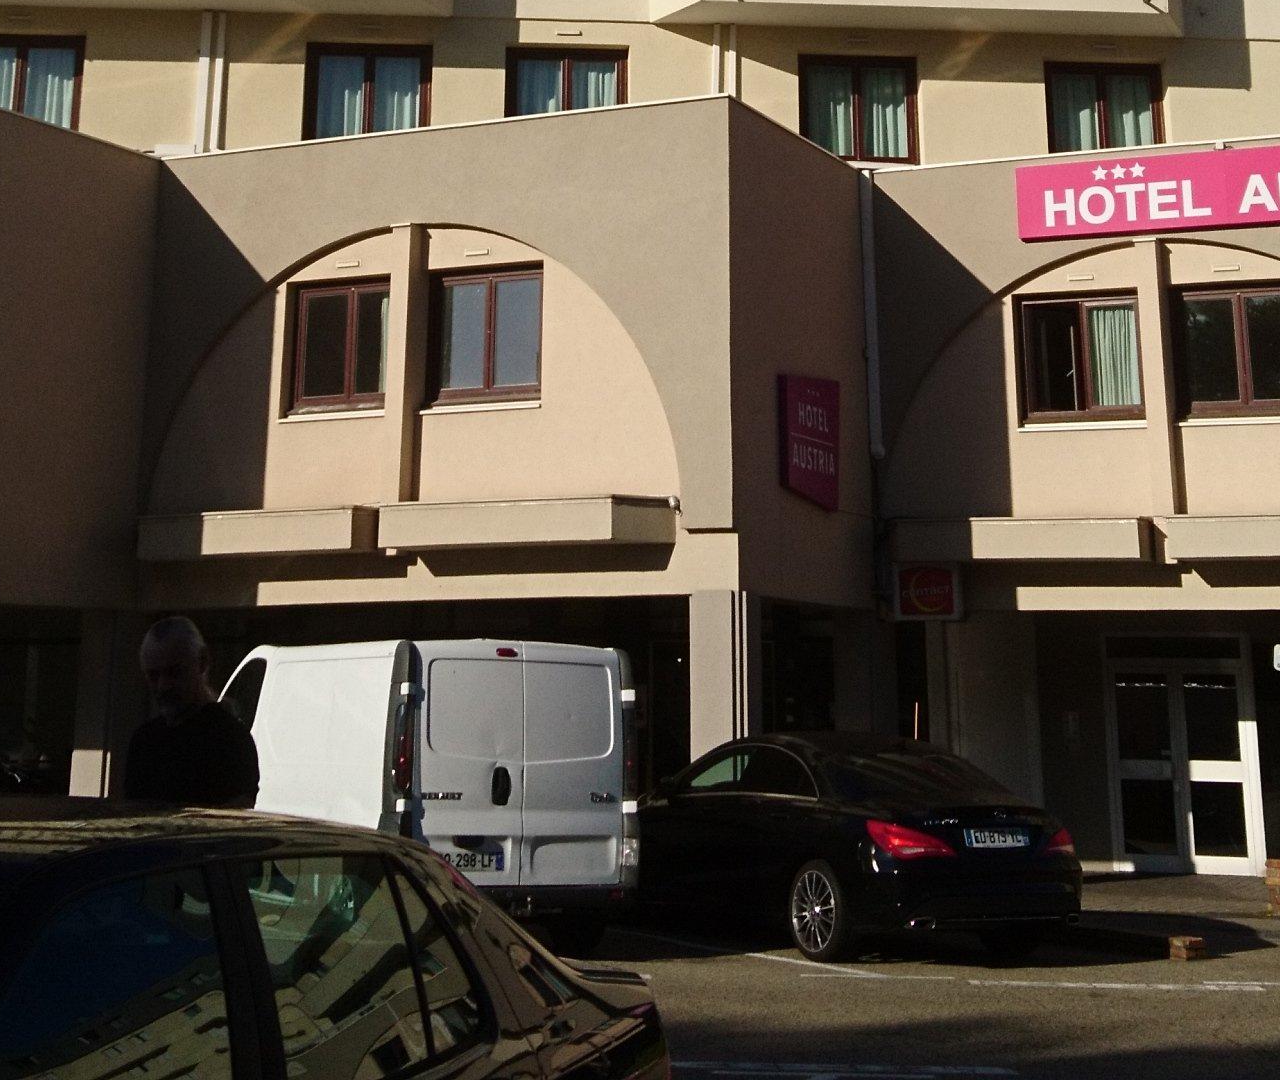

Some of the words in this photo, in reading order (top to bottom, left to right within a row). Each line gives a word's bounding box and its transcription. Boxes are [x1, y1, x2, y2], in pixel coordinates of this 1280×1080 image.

[1043, 179, 1212, 228] HOTEL
[798, 401, 829, 433] HOTEL
[792, 441, 836, 477] AUSTRIA
